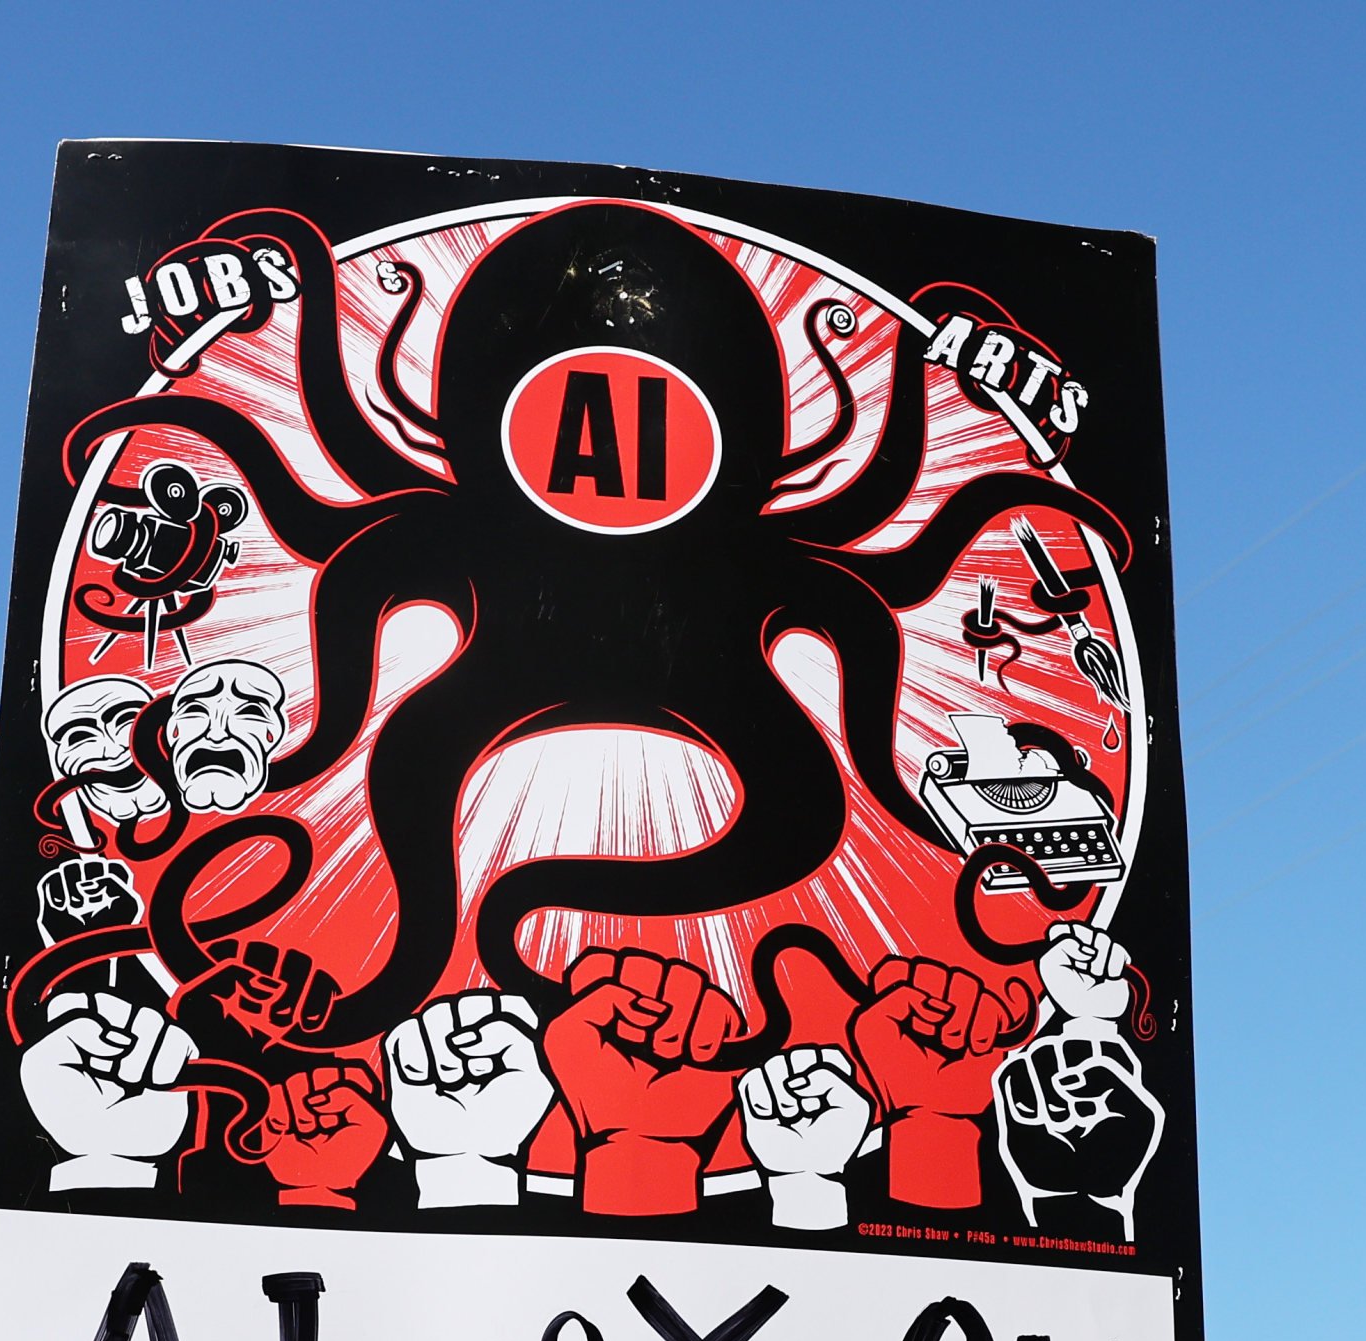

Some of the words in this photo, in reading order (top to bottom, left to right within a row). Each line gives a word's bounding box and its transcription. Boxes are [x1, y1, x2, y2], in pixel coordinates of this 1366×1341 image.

[121, 247, 297, 334] JOBS
[923, 316, 1088, 433] ARTS
[547, 370, 668, 501] AI
[858, 1222, 892, 1237] ©2023
[896, 1224, 922, 1239] Chris
[925, 1227, 949, 1241] Shaw
[1013, 1235, 1136, 1256] www.ChrisShawStudio.com
